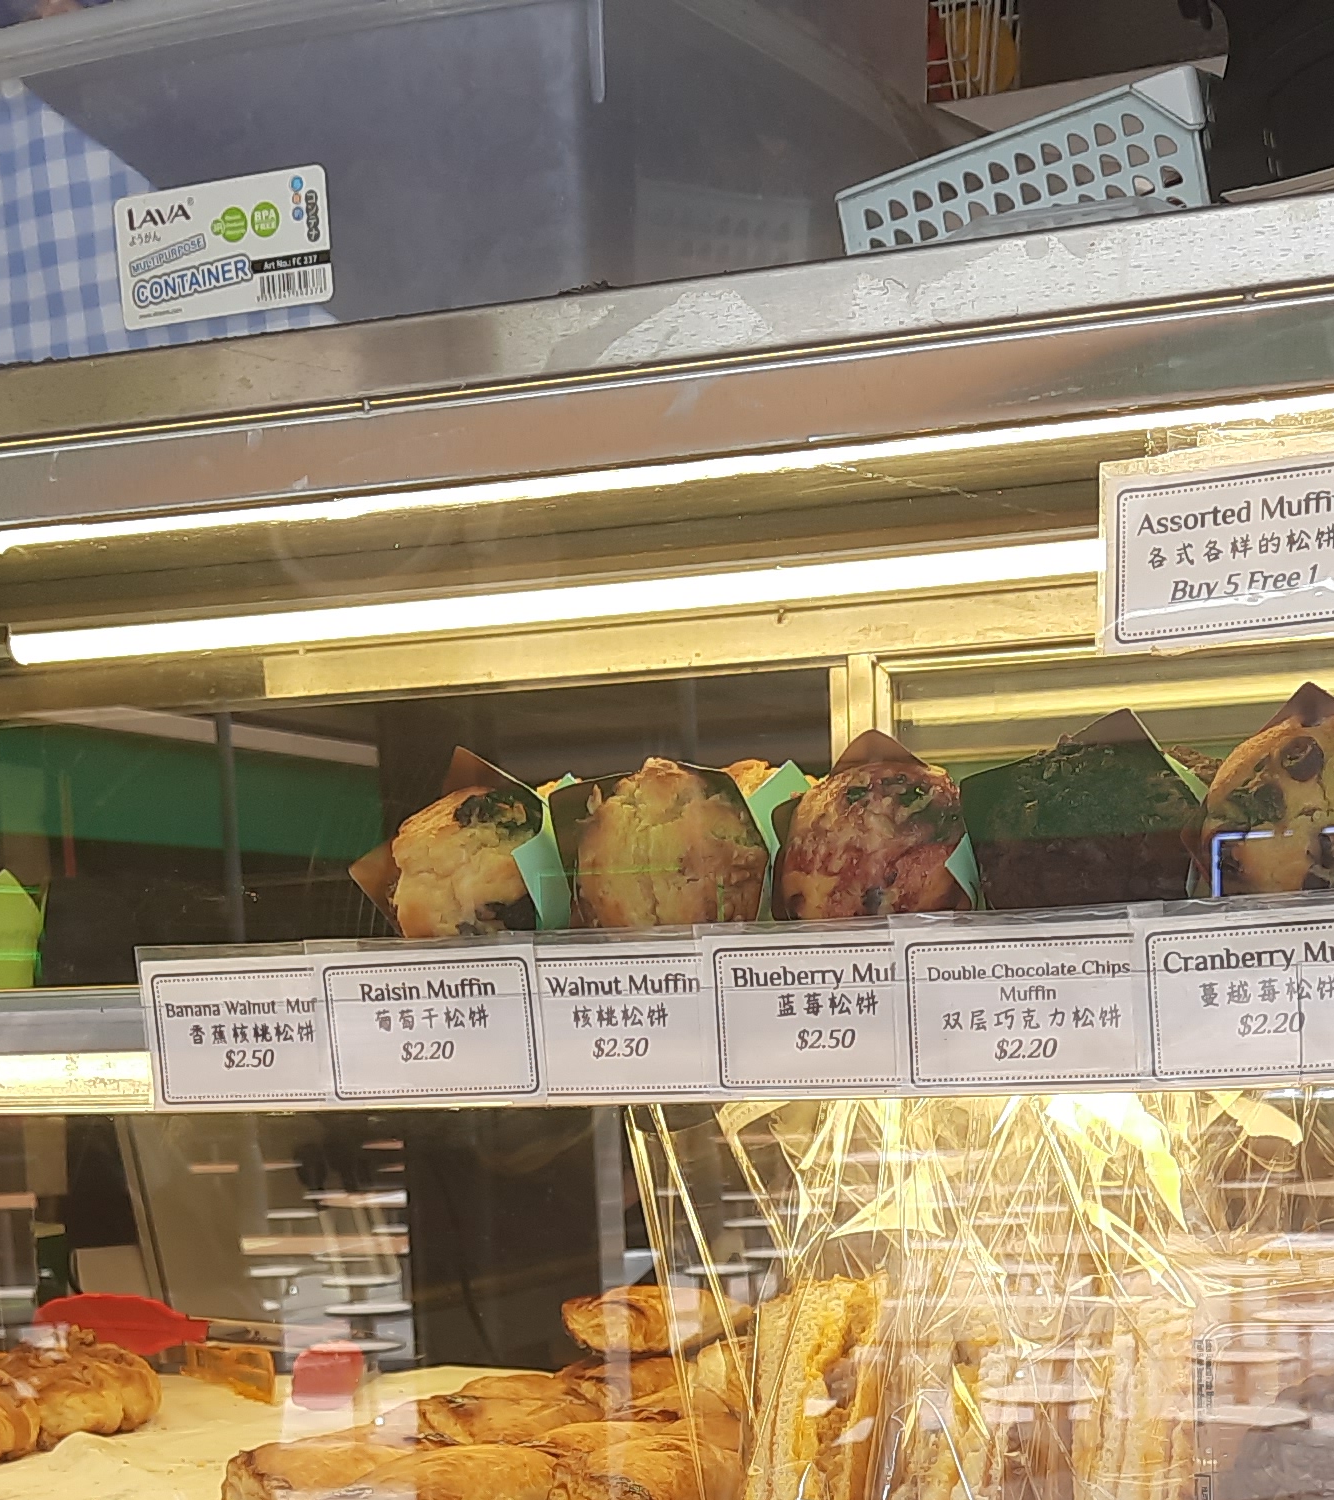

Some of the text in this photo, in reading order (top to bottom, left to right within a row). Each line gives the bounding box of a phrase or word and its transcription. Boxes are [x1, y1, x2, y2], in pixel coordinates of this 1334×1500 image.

[128, 204, 191, 230] LAVA
[254, 209, 276, 220] BPA
[132, 238, 201, 273] MULTIPURPOSE
[137, 259, 247, 303] CONTAINER
[1137, 501, 1251, 536] Assorted
[1172, 571, 1300, 601] Buy 5 Free
[927, 960, 1130, 981] Double Chocolate Chips
[1164, 948, 1295, 973] Cranberry
[359, 978, 496, 1001] Raisin Muffin
[545, 973, 700, 996] Walnut Muffin
[731, 966, 844, 990] Blueberry
[777, 990, 878, 1017] 蓝莓松饼
[1000, 985, 1056, 1001] Muffin
[165, 1000, 277, 1018] Banana Walnut
[376, 1003, 489, 1031] 葡萄干松饼
[573, 1002, 668, 1028] 核桃松饼
[943, 1004, 1121, 1031] 双层巧克力松饼
[1238, 1012, 1305, 1037] $2.20
[401, 1041, 454, 1062] $2.20
[593, 1037, 649, 1059] $2.30
[796, 1029, 855, 1050] $2.50
[995, 1038, 1057, 1060] $2.20
[225, 1049, 275, 1070] $2.50
